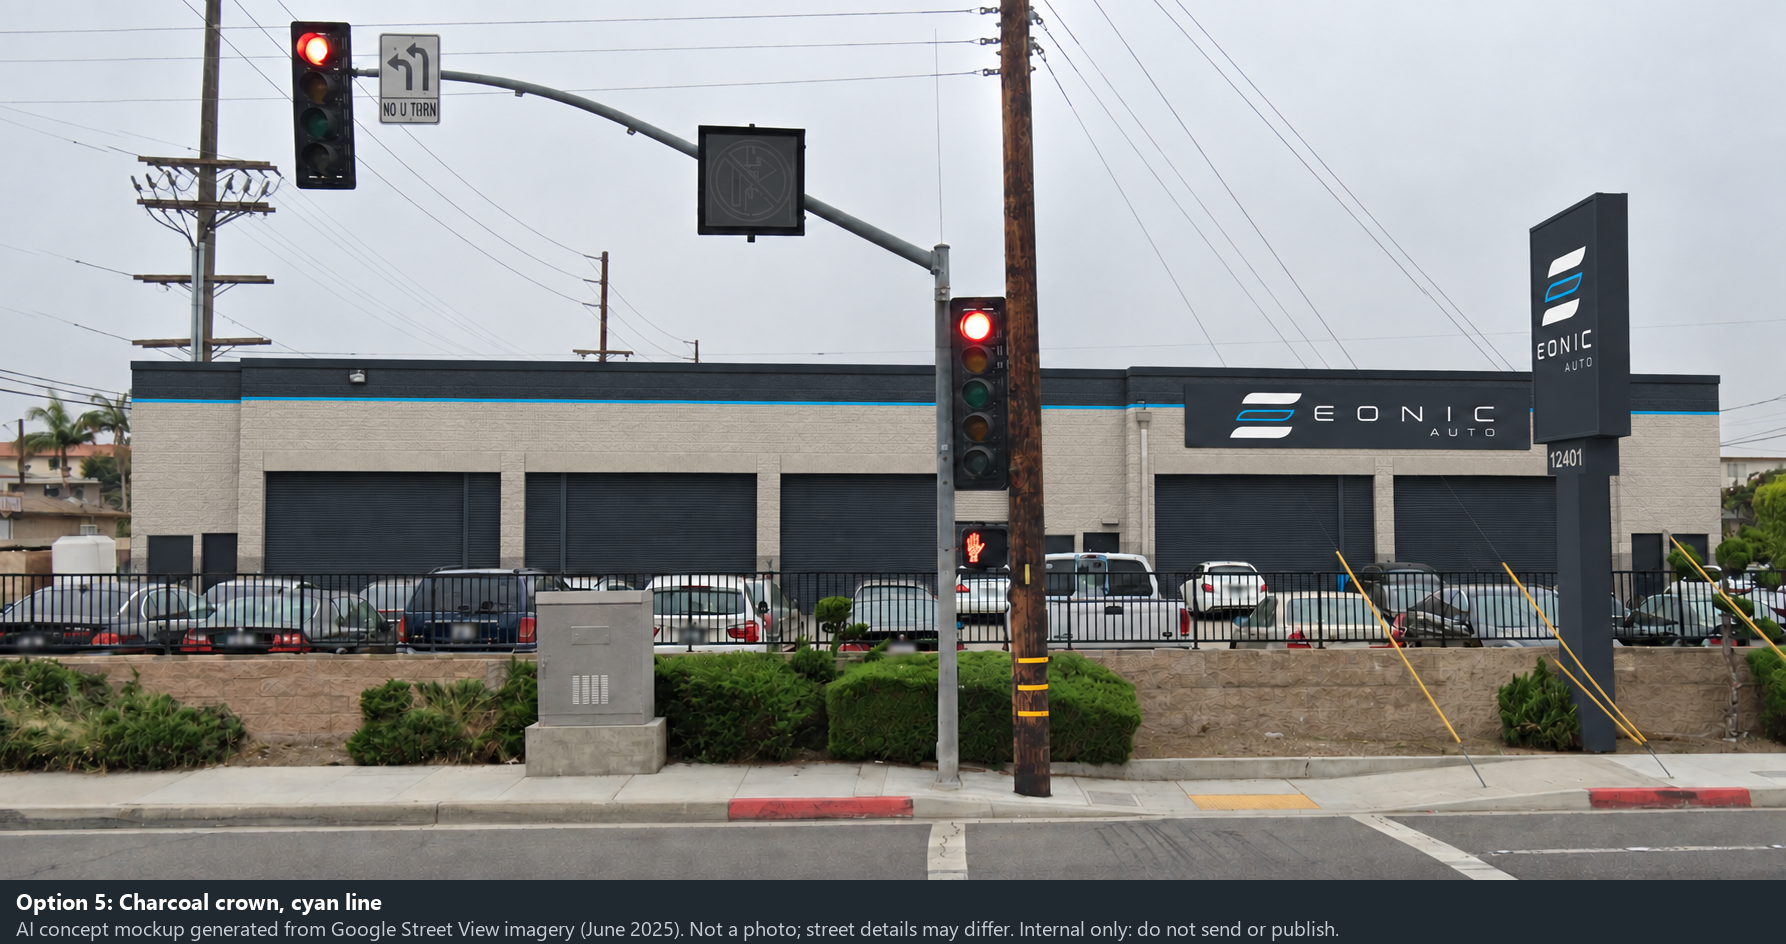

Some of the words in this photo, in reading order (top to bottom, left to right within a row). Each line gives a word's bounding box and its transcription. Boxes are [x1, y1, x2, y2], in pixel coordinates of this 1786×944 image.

[383, 102, 396, 117] NO
[400, 102, 407, 117] U
[1537, 329, 1592, 361] EONIC
[1564, 356, 1593, 373] AUTO
[1313, 405, 1495, 423] EONIC
[1429, 427, 1496, 437] AUTO
[1550, 448, 1582, 468] 12401
